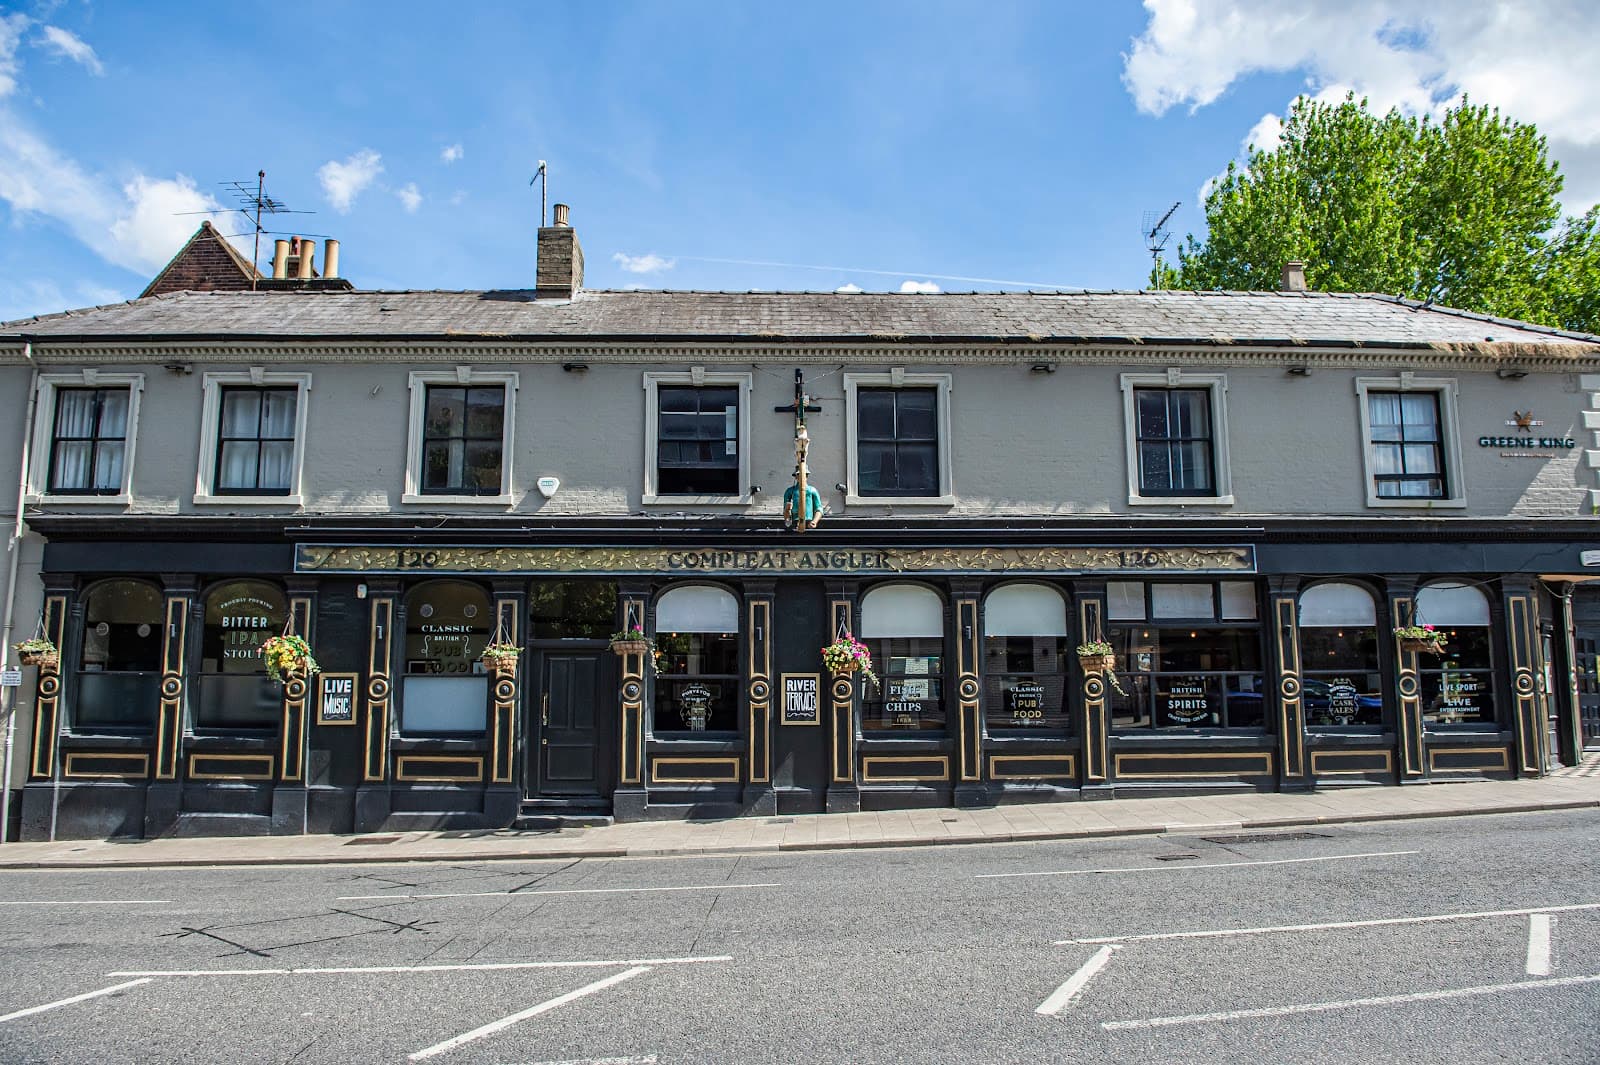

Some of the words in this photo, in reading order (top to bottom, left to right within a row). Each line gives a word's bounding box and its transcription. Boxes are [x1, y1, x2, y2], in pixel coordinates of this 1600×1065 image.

[1478, 437, 1535, 449] GREENE
[1538, 438, 1575, 449] KING
[397, 551, 438, 568] 120
[667, 551, 791, 569] COMPLEAT
[798, 551, 889, 569] ANGLER
[1119, 551, 1160, 567] 120
[222, 616, 268, 628] BITTER
[421, 625, 473, 633] CLASSIC
[231, 631, 259, 645] IPA
[432, 645, 462, 657] PUB
[324, 679, 352, 693] LIVE
[786, 679, 817, 691] RIVER
[889, 686, 918, 695] FISH
[1439, 683, 1455, 691] LVE
[1456, 683, 1478, 691] SPORT
[323, 693, 349, 715] MUSIC
[886, 702, 922, 712] CHIPS
[1017, 699, 1037, 708] PUB
[1168, 699, 1208, 709] SPIRITS
[1447, 698, 1472, 706] LIVE
[1013, 710, 1042, 718] FOOD
